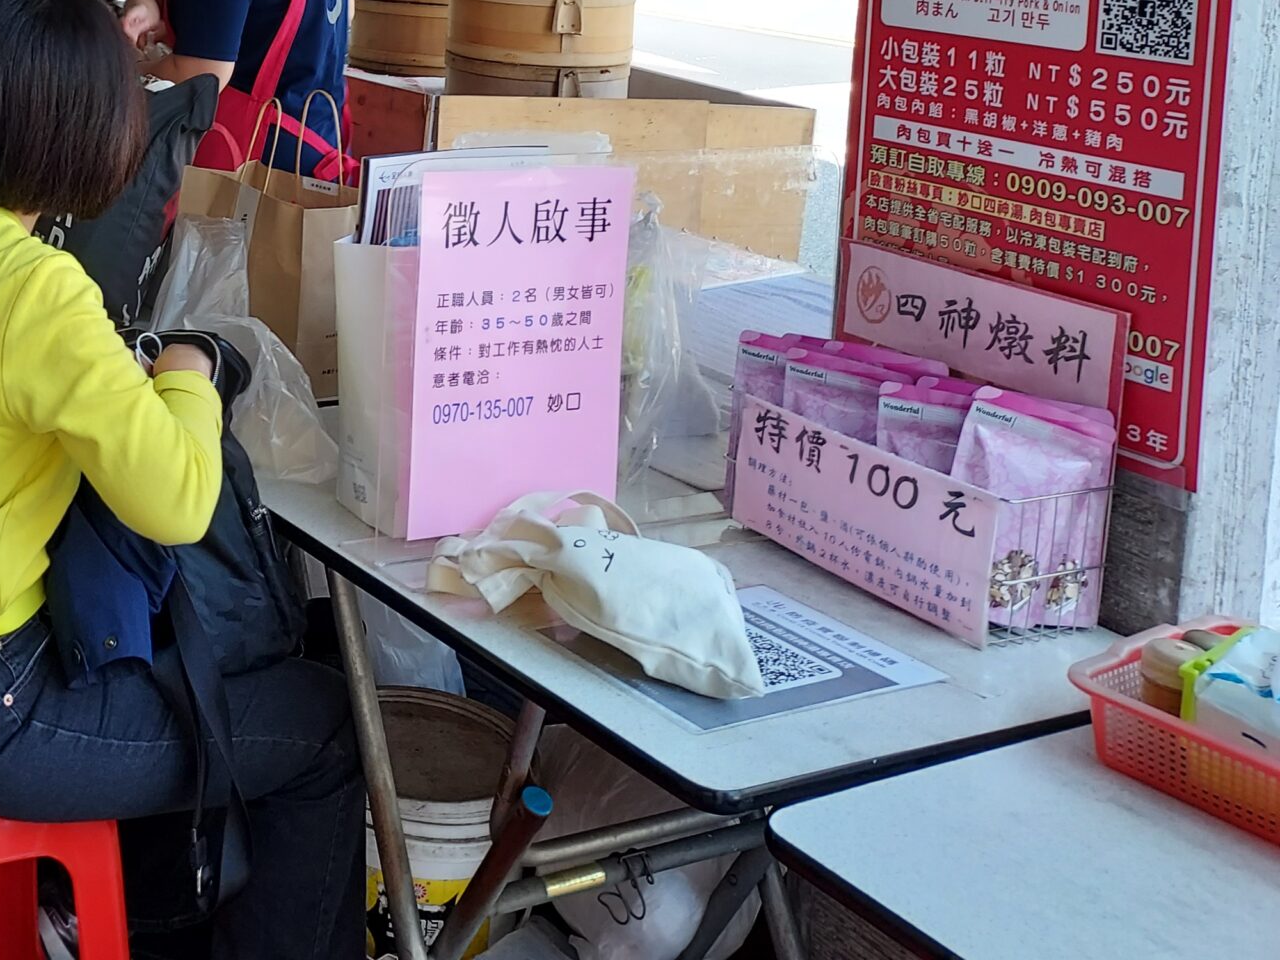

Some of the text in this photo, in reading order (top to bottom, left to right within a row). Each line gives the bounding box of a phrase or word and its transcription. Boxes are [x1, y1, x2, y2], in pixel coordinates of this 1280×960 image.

[916, 0, 960, 20] 肉まん
[1053, 0, 1081, 15] Onion
[880, 37, 1007, 78] 小包裝11粒
[878, 64, 1005, 108] 大包裝25粒
[897, 124, 1152, 189] 肉包買十送一 冷熱可混搭
[443, 197, 614, 250] 徵人啟事
[742, 347, 775, 362] Wonderful
[789, 364, 824, 380] Wonderful
[433, 392, 582, 426] 0970-135-007 妙口
[883, 401, 920, 416] Wonderful
[975, 405, 1012, 424] Wonderful
[755, 409, 976, 538] 特價 100 元
